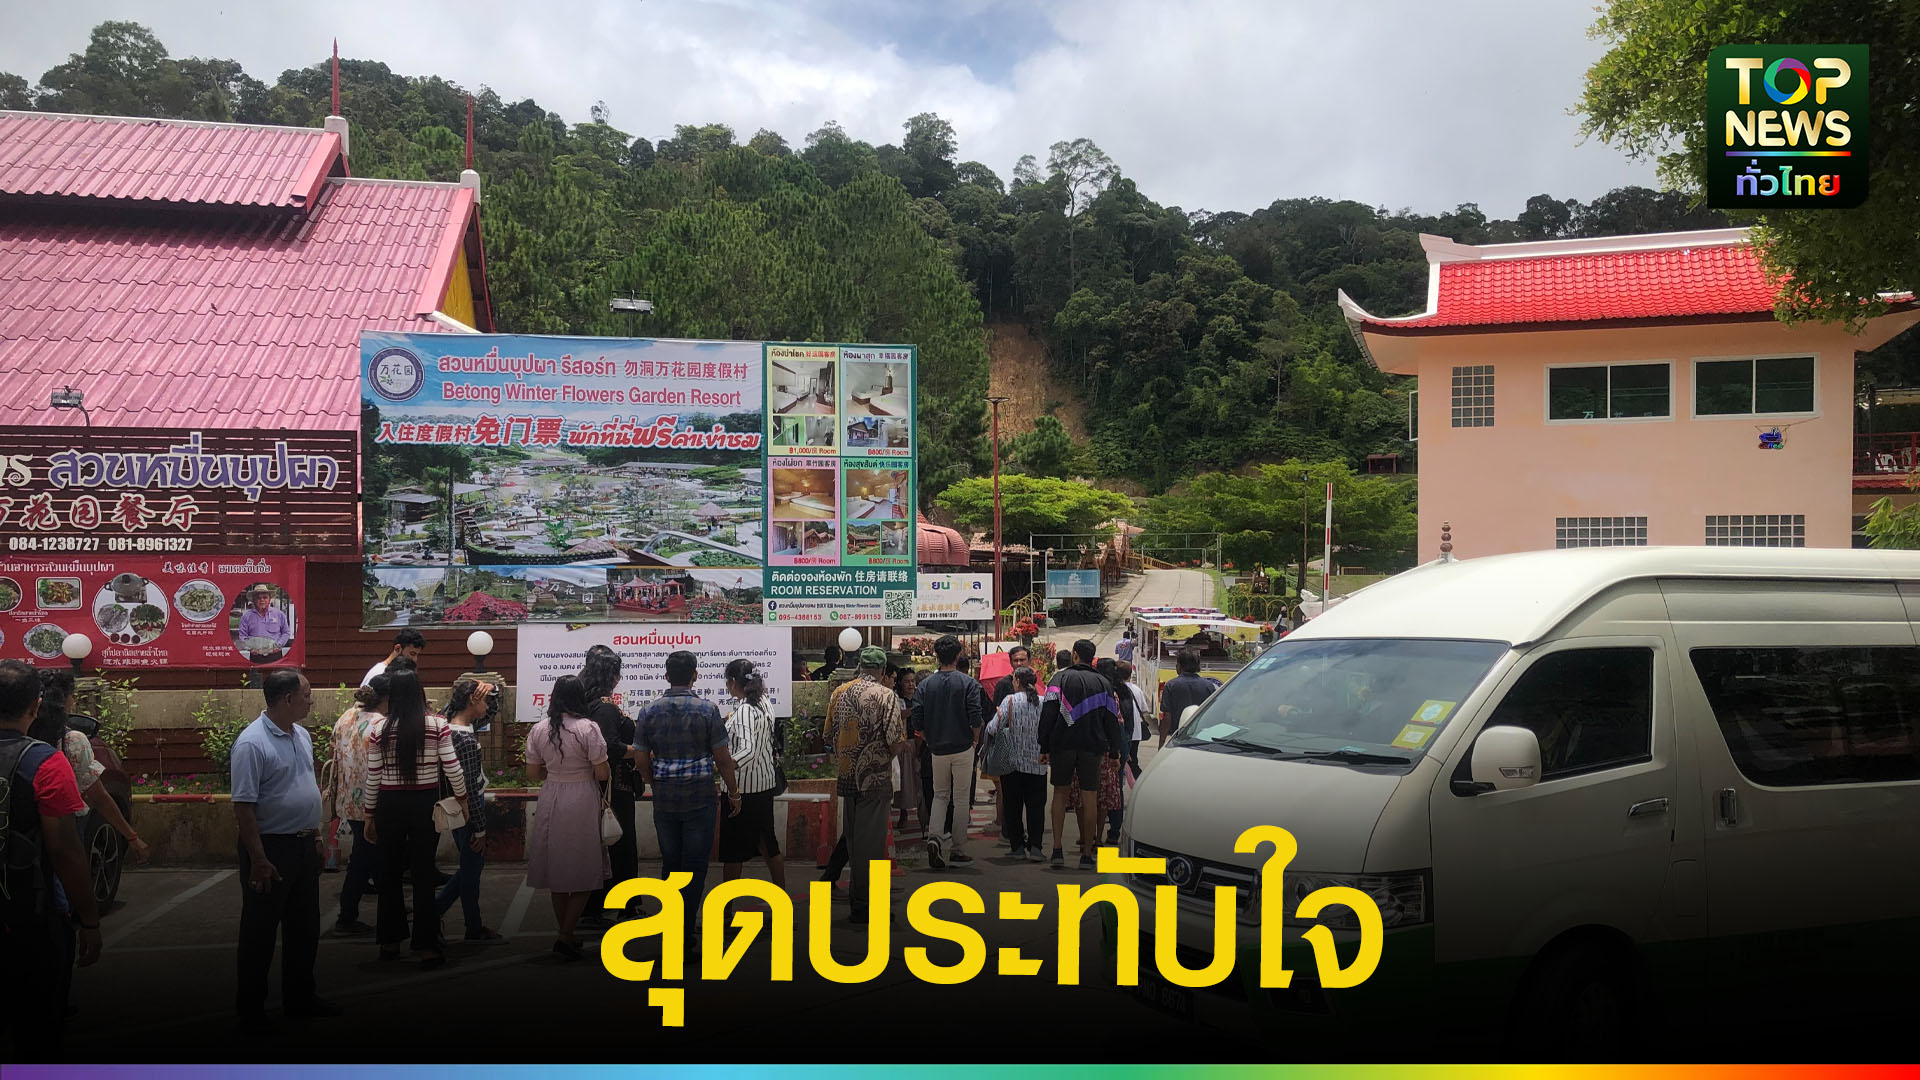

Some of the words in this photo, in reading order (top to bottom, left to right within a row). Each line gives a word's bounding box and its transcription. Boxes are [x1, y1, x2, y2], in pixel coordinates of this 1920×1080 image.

[380, 364, 414, 376] 万花园
[440, 347, 556, 379] สวนหมื่นบุปผา
[562, 355, 616, 376] รีสอร์ท
[624, 359, 748, 379] 勿洞万花园度假村
[443, 383, 501, 405] Betong
[505, 384, 558, 401] Winter
[562, 385, 624, 404] Flowers
[629, 387, 686, 405] Garden
[691, 388, 741, 406] Resort
[378, 414, 564, 445] 入住度假村免门票
[568, 416, 761, 448] พักที่นี่ฟรีค่าเข้าชม
[819, 447, 836, 455] Room
[47, 431, 339, 502] สวนหมื่นบุปผา
[9, 537, 100, 551] 084-1238727
[108, 537, 193, 551] 081-8961327
[0, 560, 115, 576] านอาหารสวนหมื่นบุปผา
[818, 557, 836, 565] Room
[892, 557, 910, 565] Room
[771, 570, 852, 583] ติดต่อจองห้องพัก
[855, 570, 908, 583] 住房请联络
[771, 585, 802, 595] ROOM
[805, 585, 877, 595] RESERVATION
[613, 628, 701, 648] สวนหมื่นบุปผา
